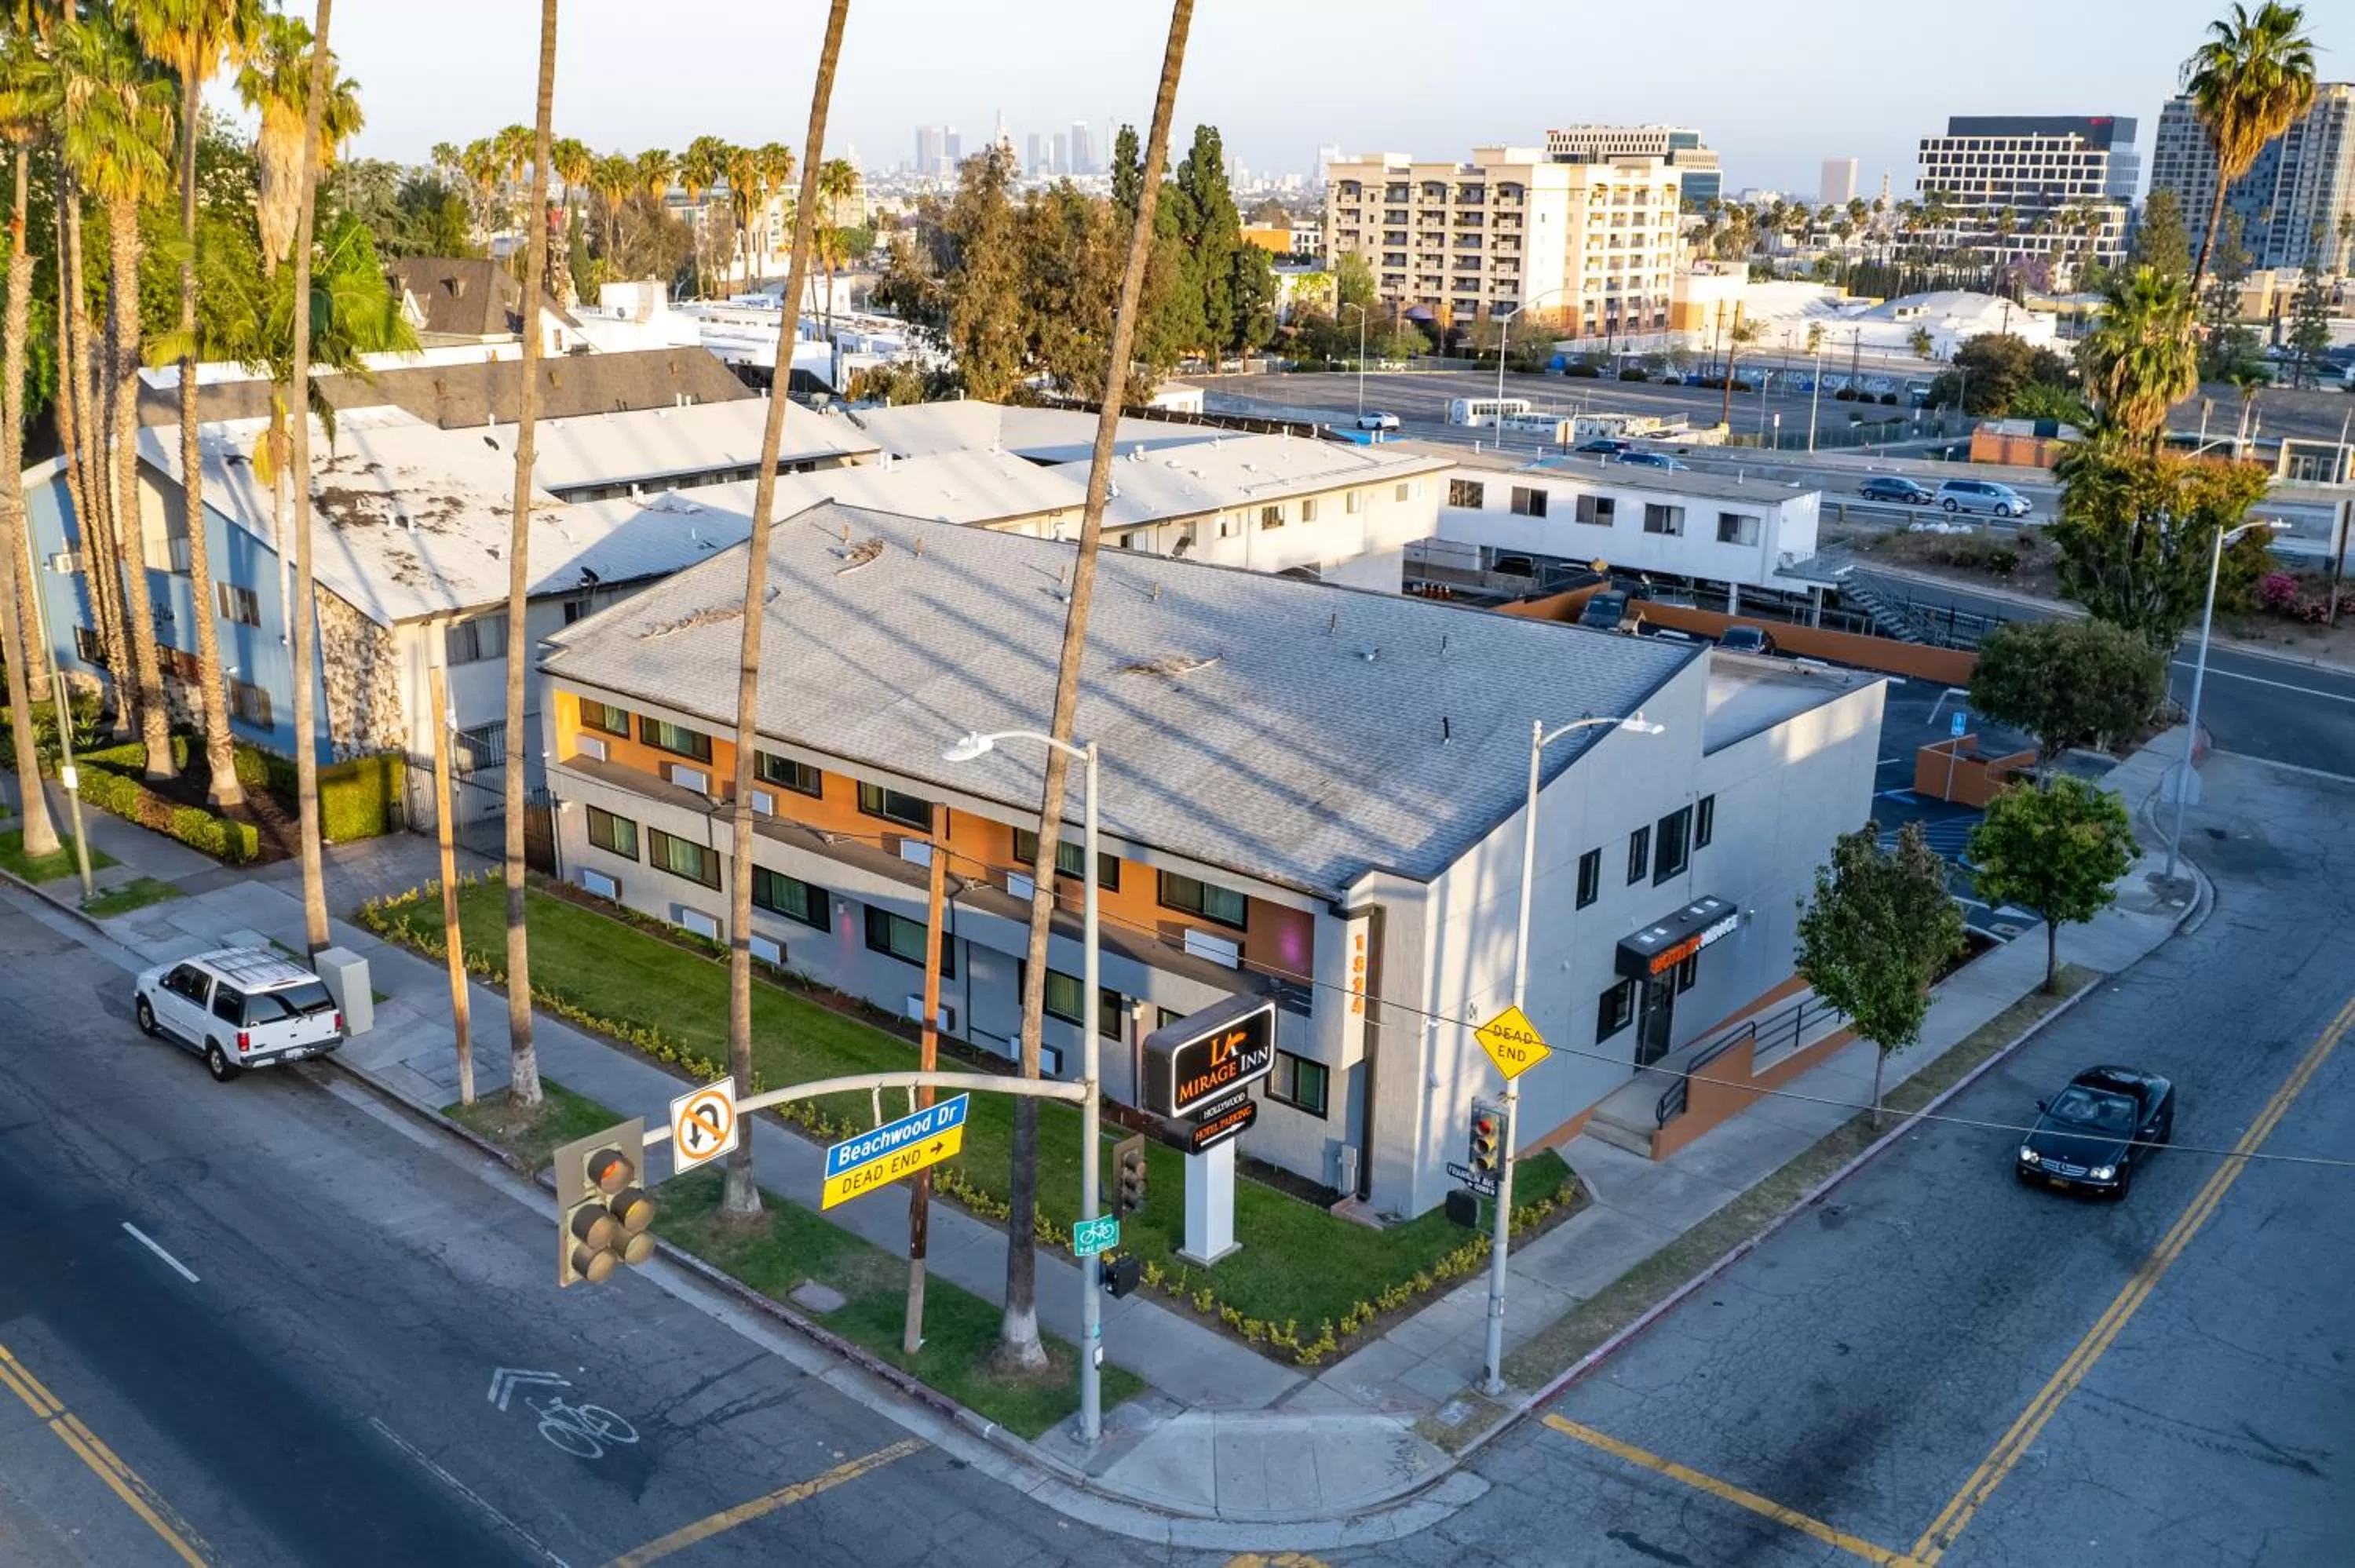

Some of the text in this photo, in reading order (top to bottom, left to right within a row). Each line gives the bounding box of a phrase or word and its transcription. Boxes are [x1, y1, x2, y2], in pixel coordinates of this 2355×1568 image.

[1210, 1031, 1247, 1067] LA
[1494, 1024, 1532, 1044] DEAD
[1498, 1045, 1526, 1062] END
[1179, 1045, 1269, 1103] MIRAGE INN
[1195, 1106, 1252, 1142] HOTEL PARKING
[1203, 1092, 1246, 1120] HOLLYWOOD
[838, 1104, 958, 1167] Beachwood Dr
[842, 1149, 921, 1194] DEAD END
